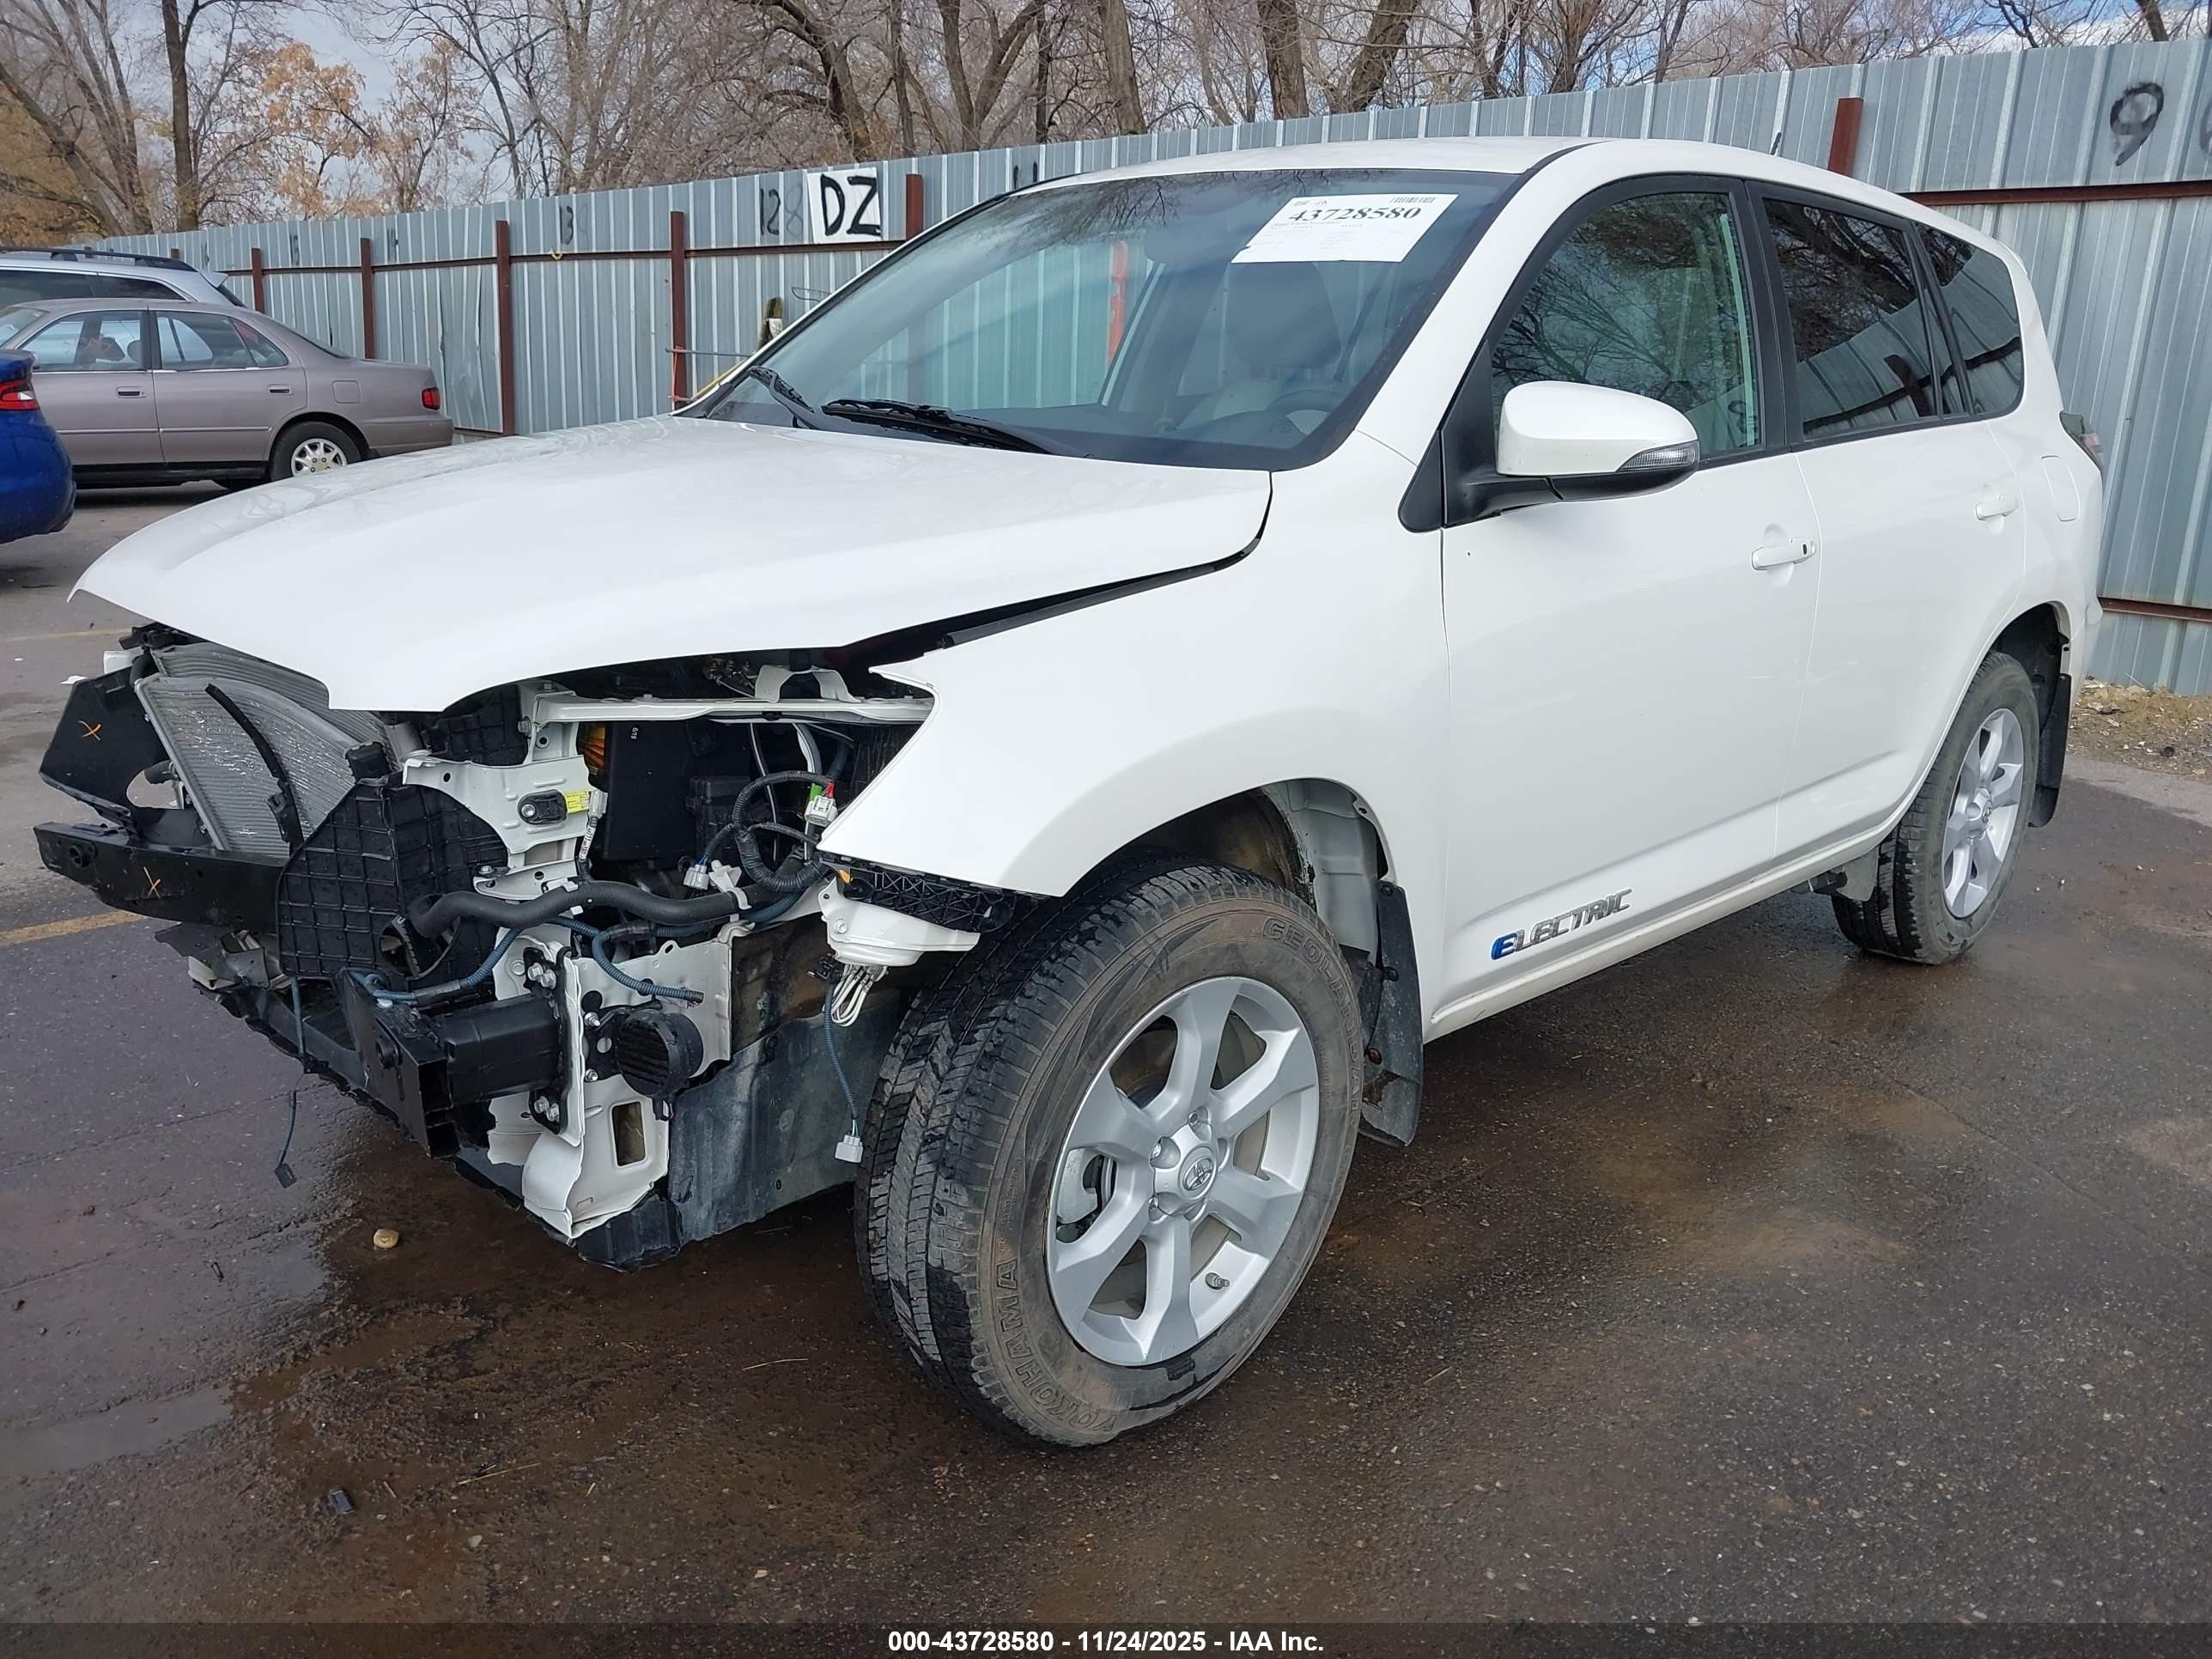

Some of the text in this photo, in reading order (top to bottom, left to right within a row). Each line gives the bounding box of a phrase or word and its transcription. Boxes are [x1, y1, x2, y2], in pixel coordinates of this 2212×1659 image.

[559, 205, 574, 245] 13
[760, 189, 781, 236] 12
[820, 173, 882, 236] DZ
[1289, 207, 1422, 222] 43728580
[1491, 888, 1632, 960] ELECTRIC
[997, 1258, 1117, 1434] YOKOHAMA
